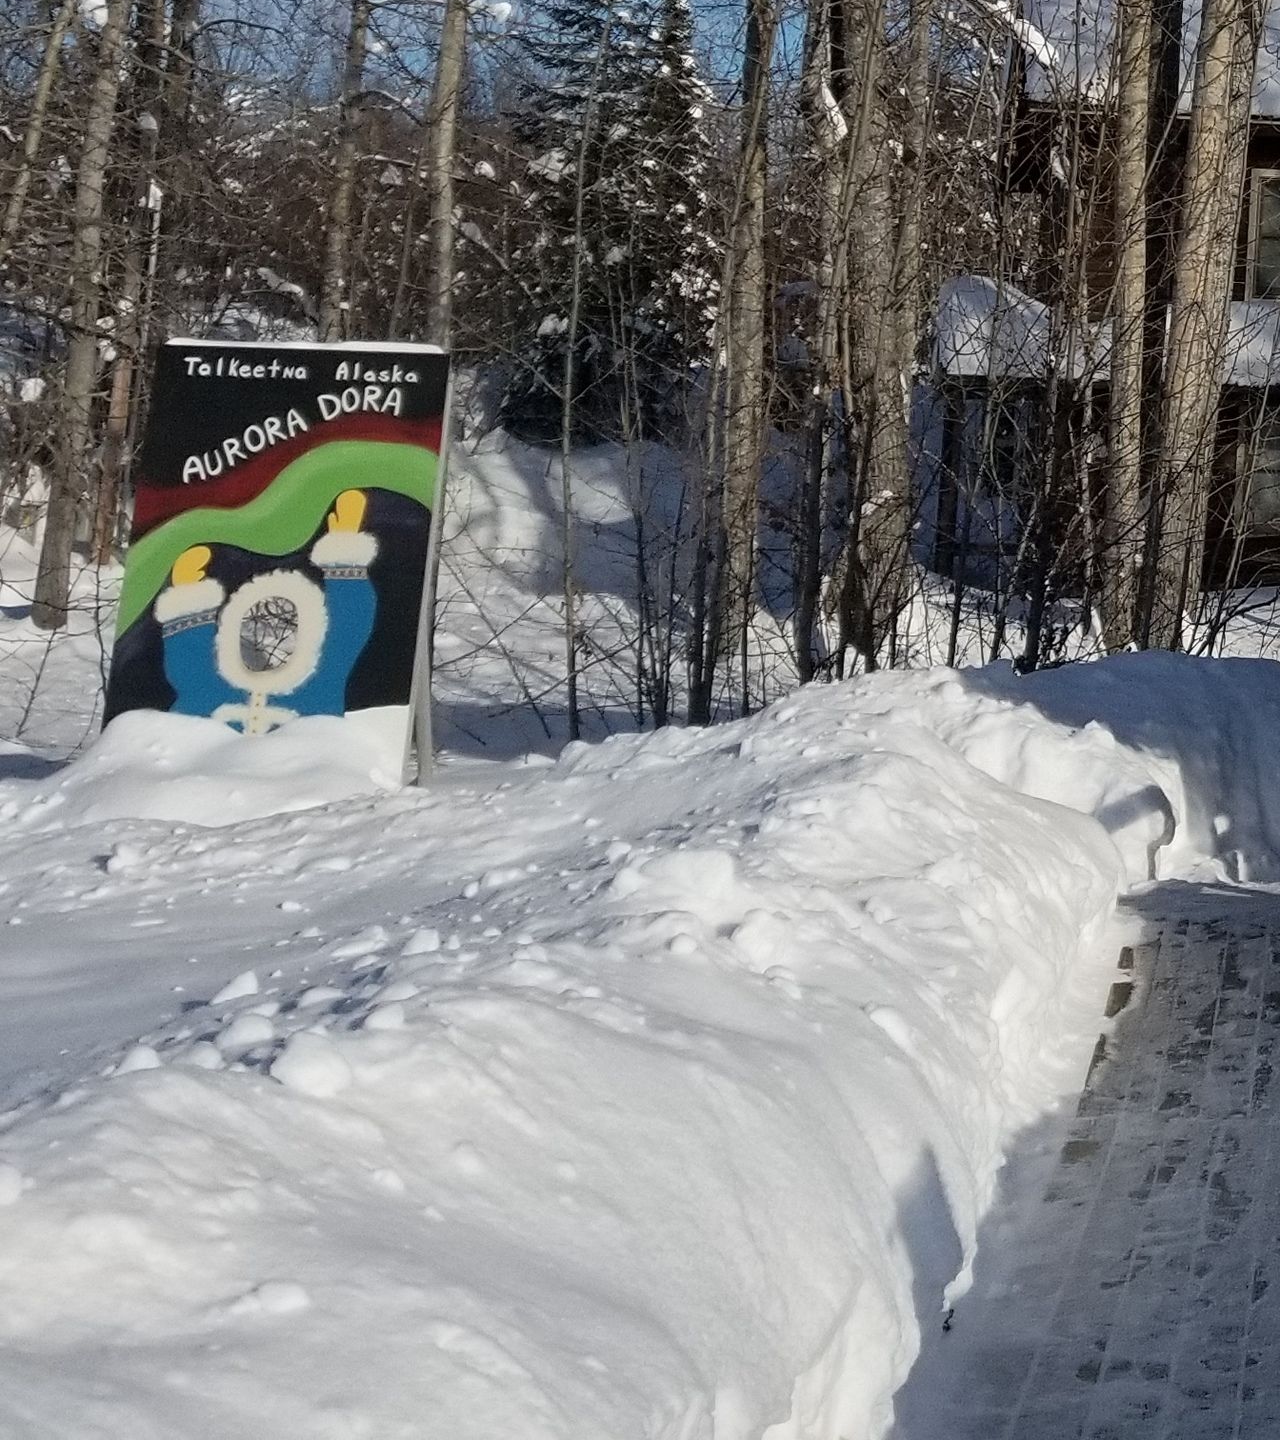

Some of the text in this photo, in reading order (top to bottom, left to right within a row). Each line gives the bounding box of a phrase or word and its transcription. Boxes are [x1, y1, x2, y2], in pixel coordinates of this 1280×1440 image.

[335, 361, 418, 383] Alaska
[182, 385, 401, 483] AURORA DORA
